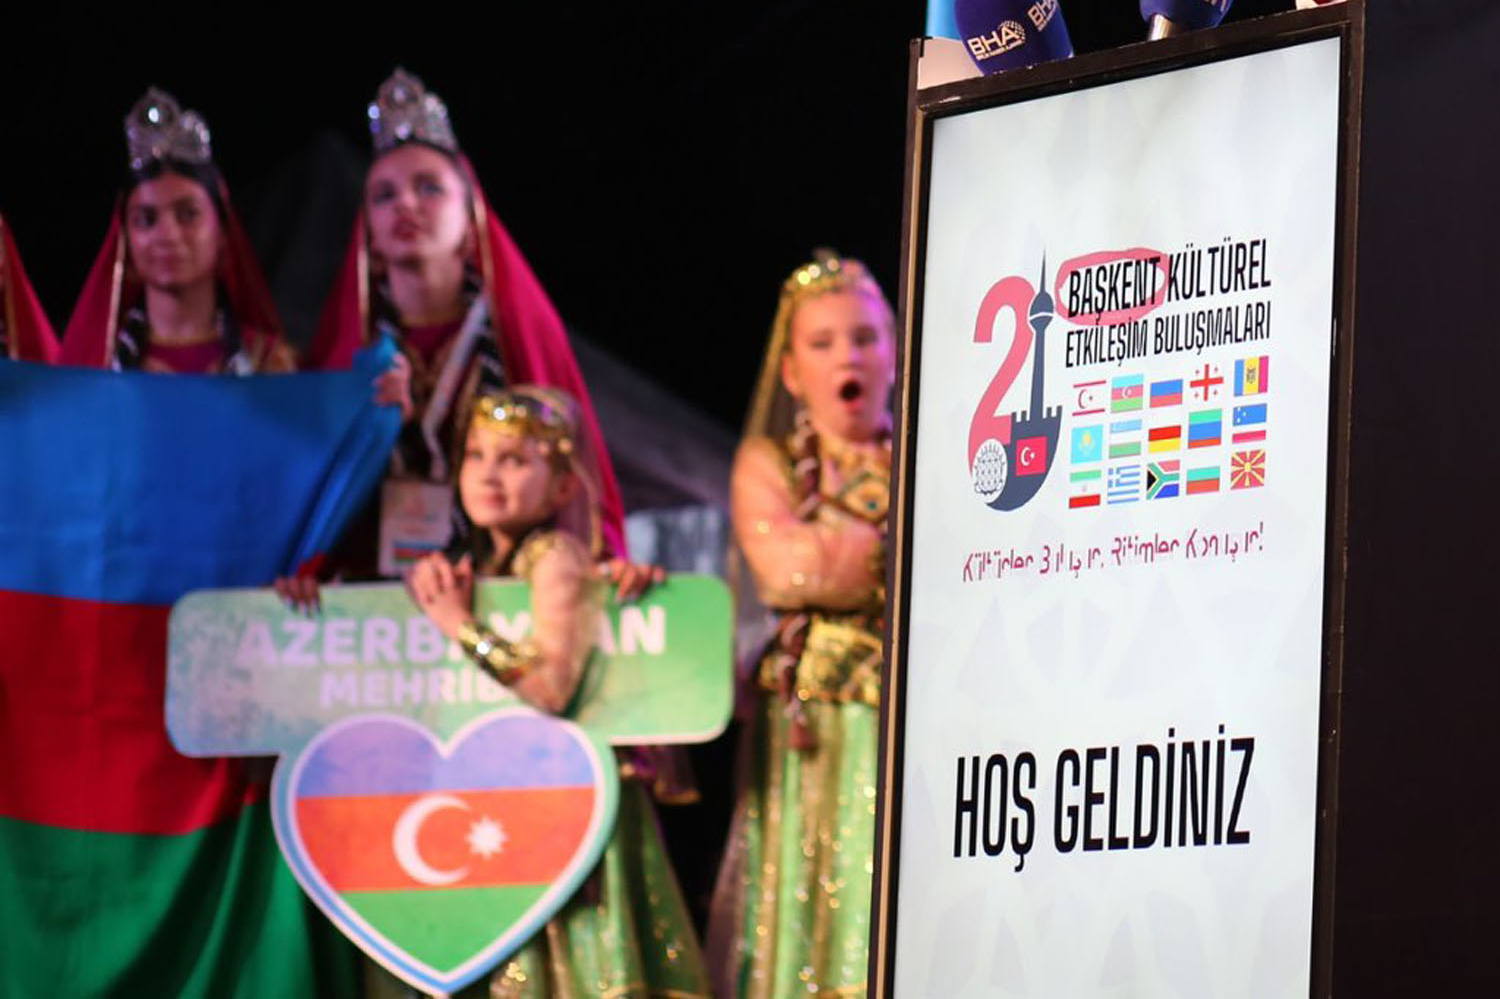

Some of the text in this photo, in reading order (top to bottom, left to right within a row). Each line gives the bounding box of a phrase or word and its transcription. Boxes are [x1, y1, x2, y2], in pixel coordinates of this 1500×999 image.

[967, 26, 1021, 56] BHA
[1068, 237, 1272, 322] BAŞKENT KÜLTÜREL
[1065, 300, 1271, 368] ETKİLEŞİM BULUŞMALARI
[953, 723, 1255, 872] HOŞ GELDİNİZ
